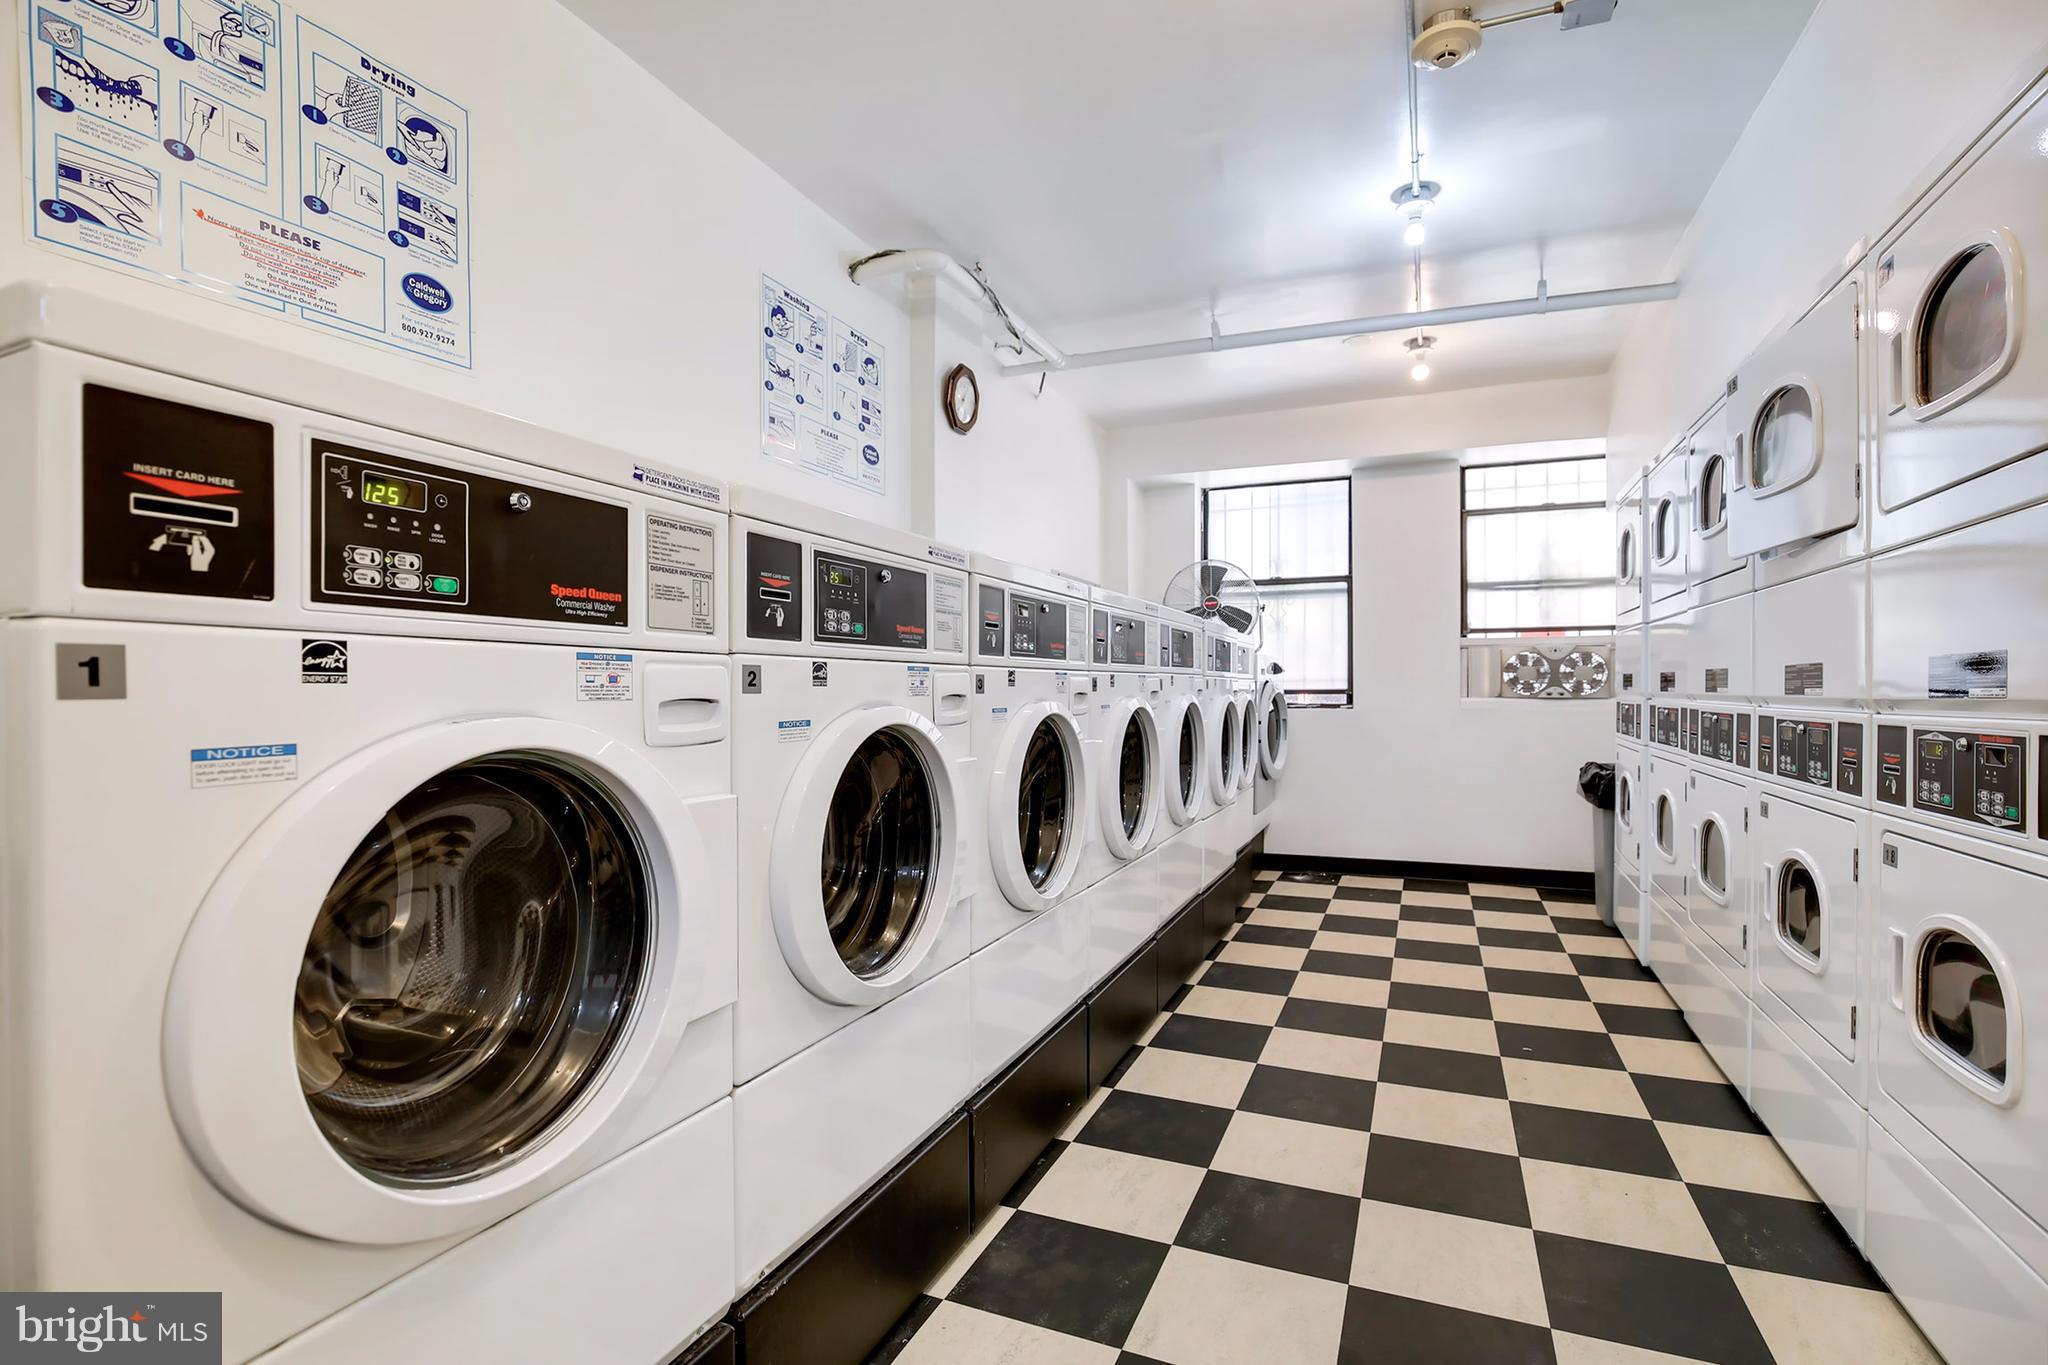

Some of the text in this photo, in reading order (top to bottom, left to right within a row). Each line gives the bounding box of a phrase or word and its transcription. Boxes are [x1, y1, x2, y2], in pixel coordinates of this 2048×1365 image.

[172, 41, 185, 58] 2
[361, 56, 416, 98] Drying
[50, 90, 64, 108] 3
[311, 108, 320, 122] 1
[170, 142, 187, 159] 4
[393, 150, 403, 161] 2
[51, 202, 67, 218] 5
[310, 199, 322, 211] 3
[207, 215, 229, 227] Never
[260, 220, 321, 251] PLEASE
[393, 232, 404, 245] 4
[239, 241, 249, 250] Do
[243, 250, 253, 258] Do
[268, 260, 284, 268] wash
[285, 266, 298, 275] rugs
[256, 262, 267, 270] Do
[268, 267, 279, 275] not
[244, 281, 258, 289] One
[260, 286, 276, 295] wash
[278, 290, 291, 300] load
[298, 297, 311, 306] One
[312, 302, 323, 310] dry
[268, 281, 280, 289] put
[281, 286, 298, 295] shoes
[409, 278, 445, 298] Caldwell
[406, 285, 448, 309] & Gregory
[783, 290, 810, 312] Washing
[401, 314, 411, 322] For
[401, 322, 455, 346] 800.927.9274
[850, 330, 868, 347] Drying
[820, 428, 839, 441] PLEASE
[133, 463, 235, 488] INSERT CARD HERE
[645, 468, 672, 480] DETERGENT
[364, 482, 400, 505] 125
[646, 474, 660, 485] PLACE
[661, 479, 667, 487] IN
[668, 481, 690, 493] MACHINE
[690, 487, 702, 496] WITH
[702, 490, 720, 501] CLOTHES
[649, 518, 713, 538] OPERATING INSTRUCTIONS
[649, 565, 713, 581] DISPENSER INSTRUCTIONS
[551, 583, 622, 602] Speed Queen
[555, 597, 616, 612] Commercial Washer
[78, 656, 101, 688] 1
[302, 675, 348, 684] ENERGY STAR
[748, 670, 757, 687] 2
[977, 678, 983, 690] 3
[207, 746, 284, 759] NOTICE
[1885, 849, 1896, 864] 18
